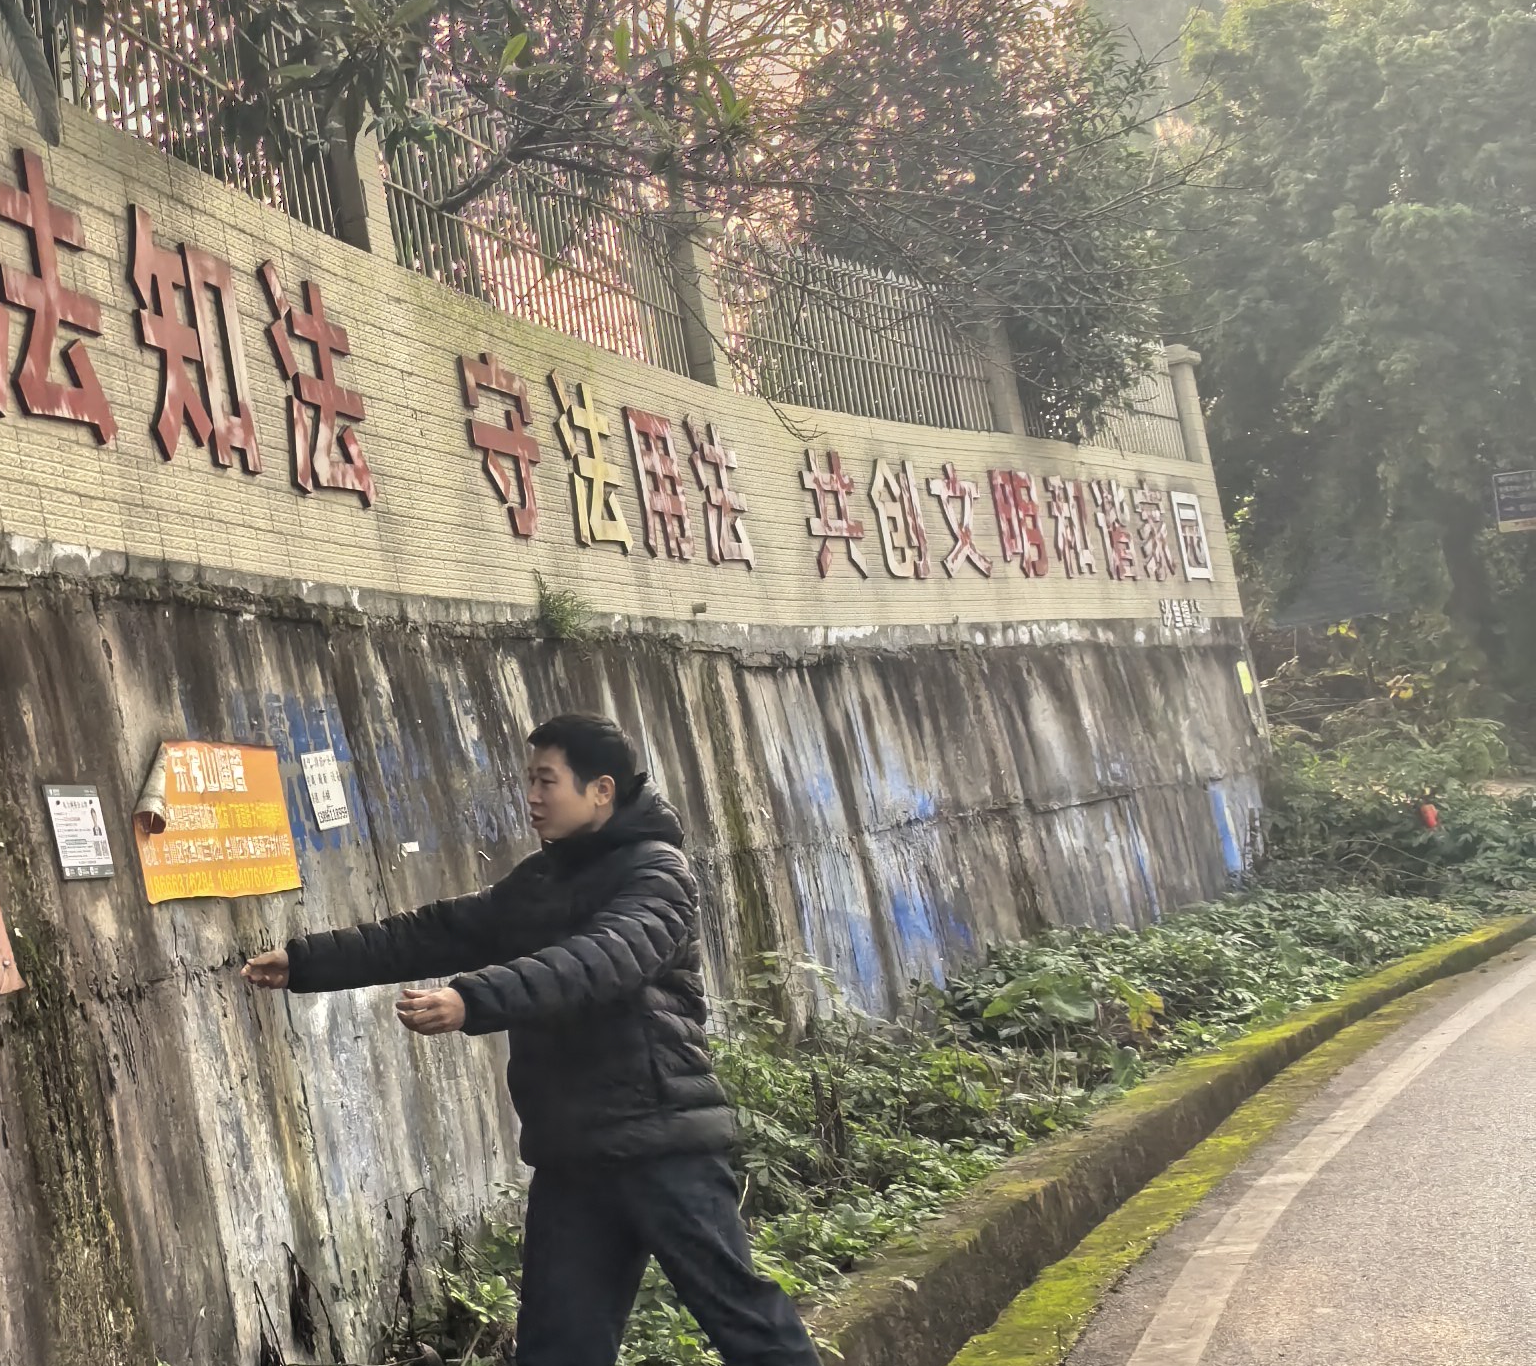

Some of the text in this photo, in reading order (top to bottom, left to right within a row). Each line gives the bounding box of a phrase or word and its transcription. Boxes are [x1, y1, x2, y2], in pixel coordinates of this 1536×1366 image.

[458, 352, 757, 571] 守法用法
[799, 448, 1214, 583] 共创文明和谐家园
